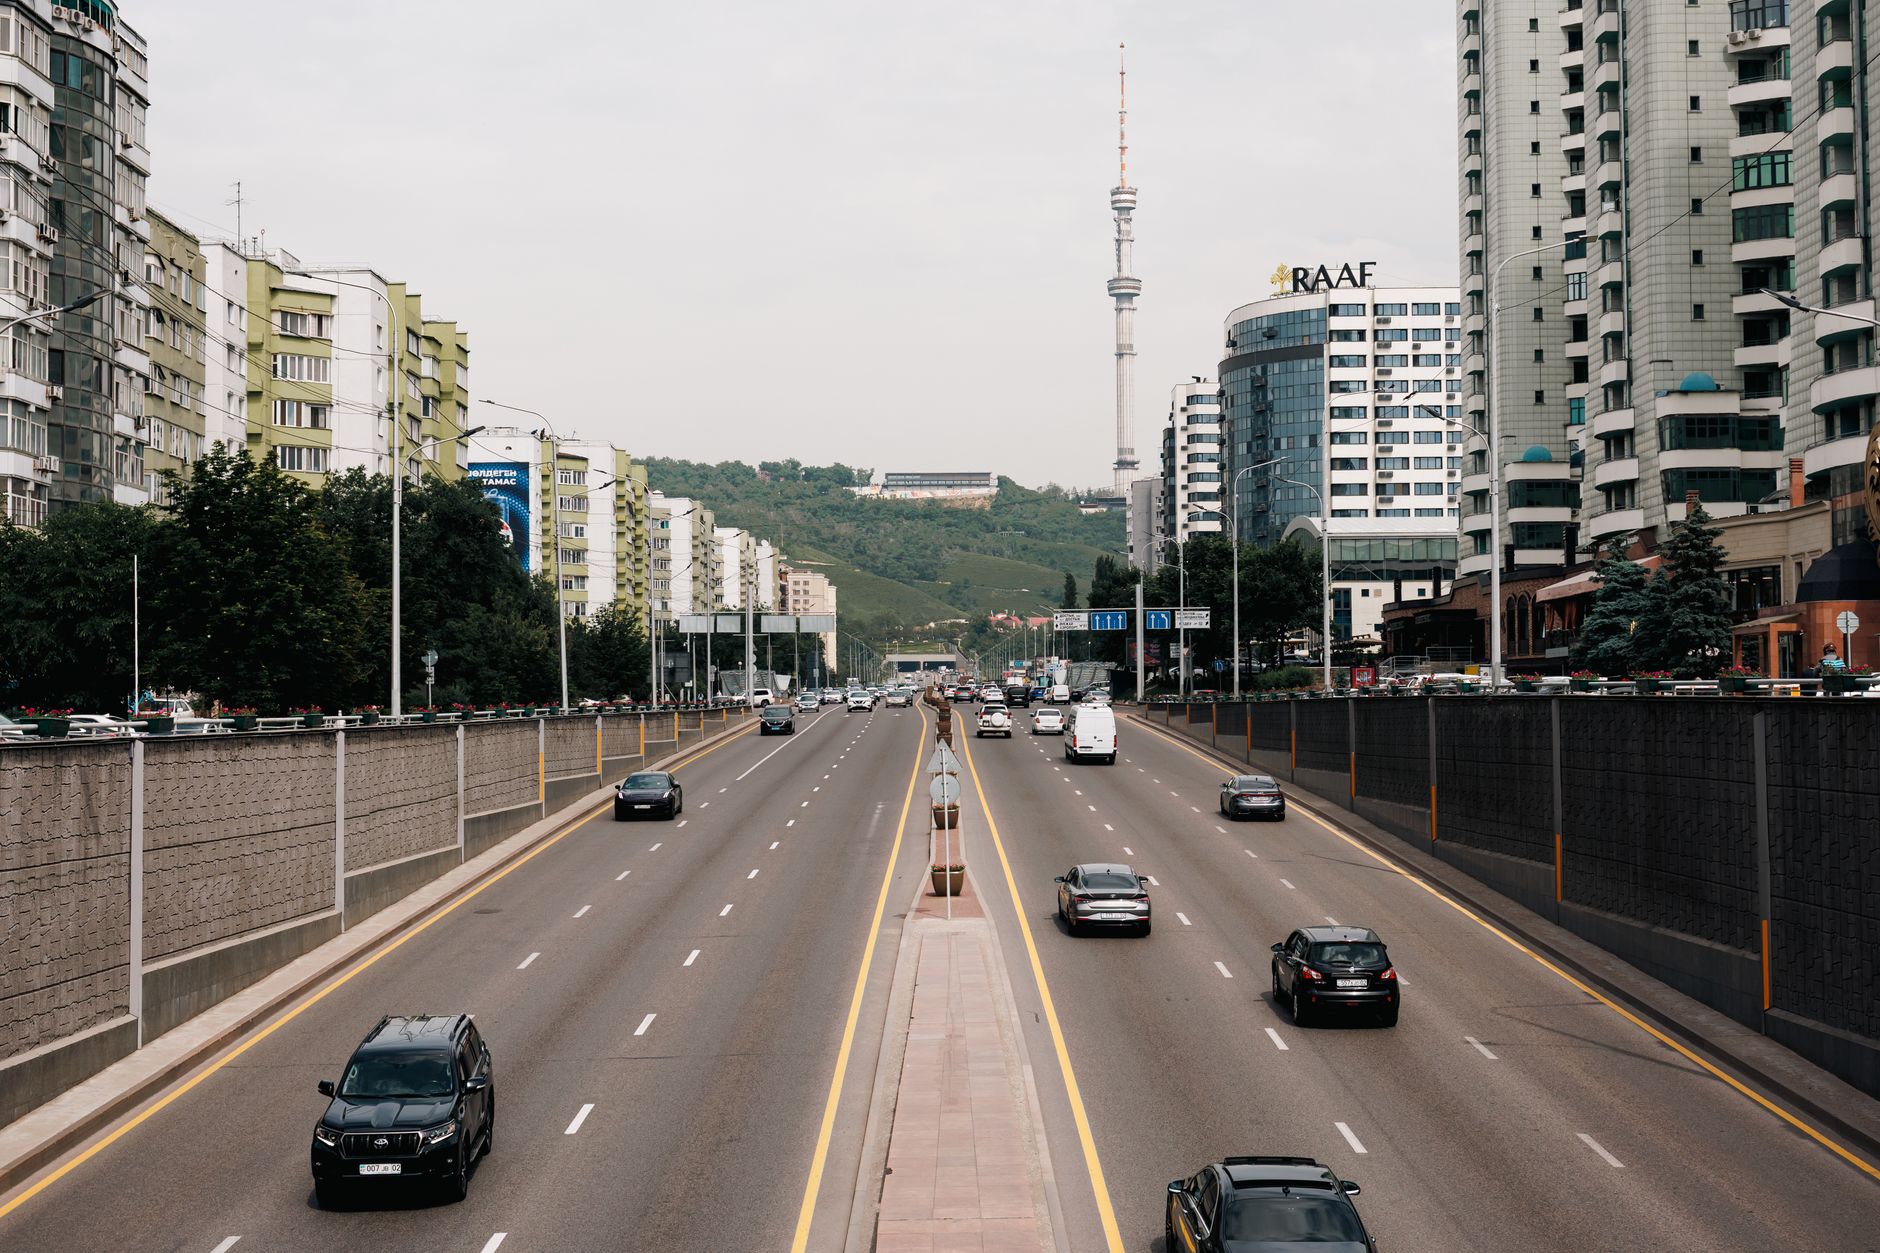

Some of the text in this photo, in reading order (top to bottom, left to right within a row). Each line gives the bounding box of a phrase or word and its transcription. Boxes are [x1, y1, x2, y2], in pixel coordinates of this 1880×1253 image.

[1292, 262, 1376, 293] RAAF
[483, 478, 517, 486] ТАМАС
[366, 1164, 380, 1172] 007
[391, 1164, 401, 1172] 02
